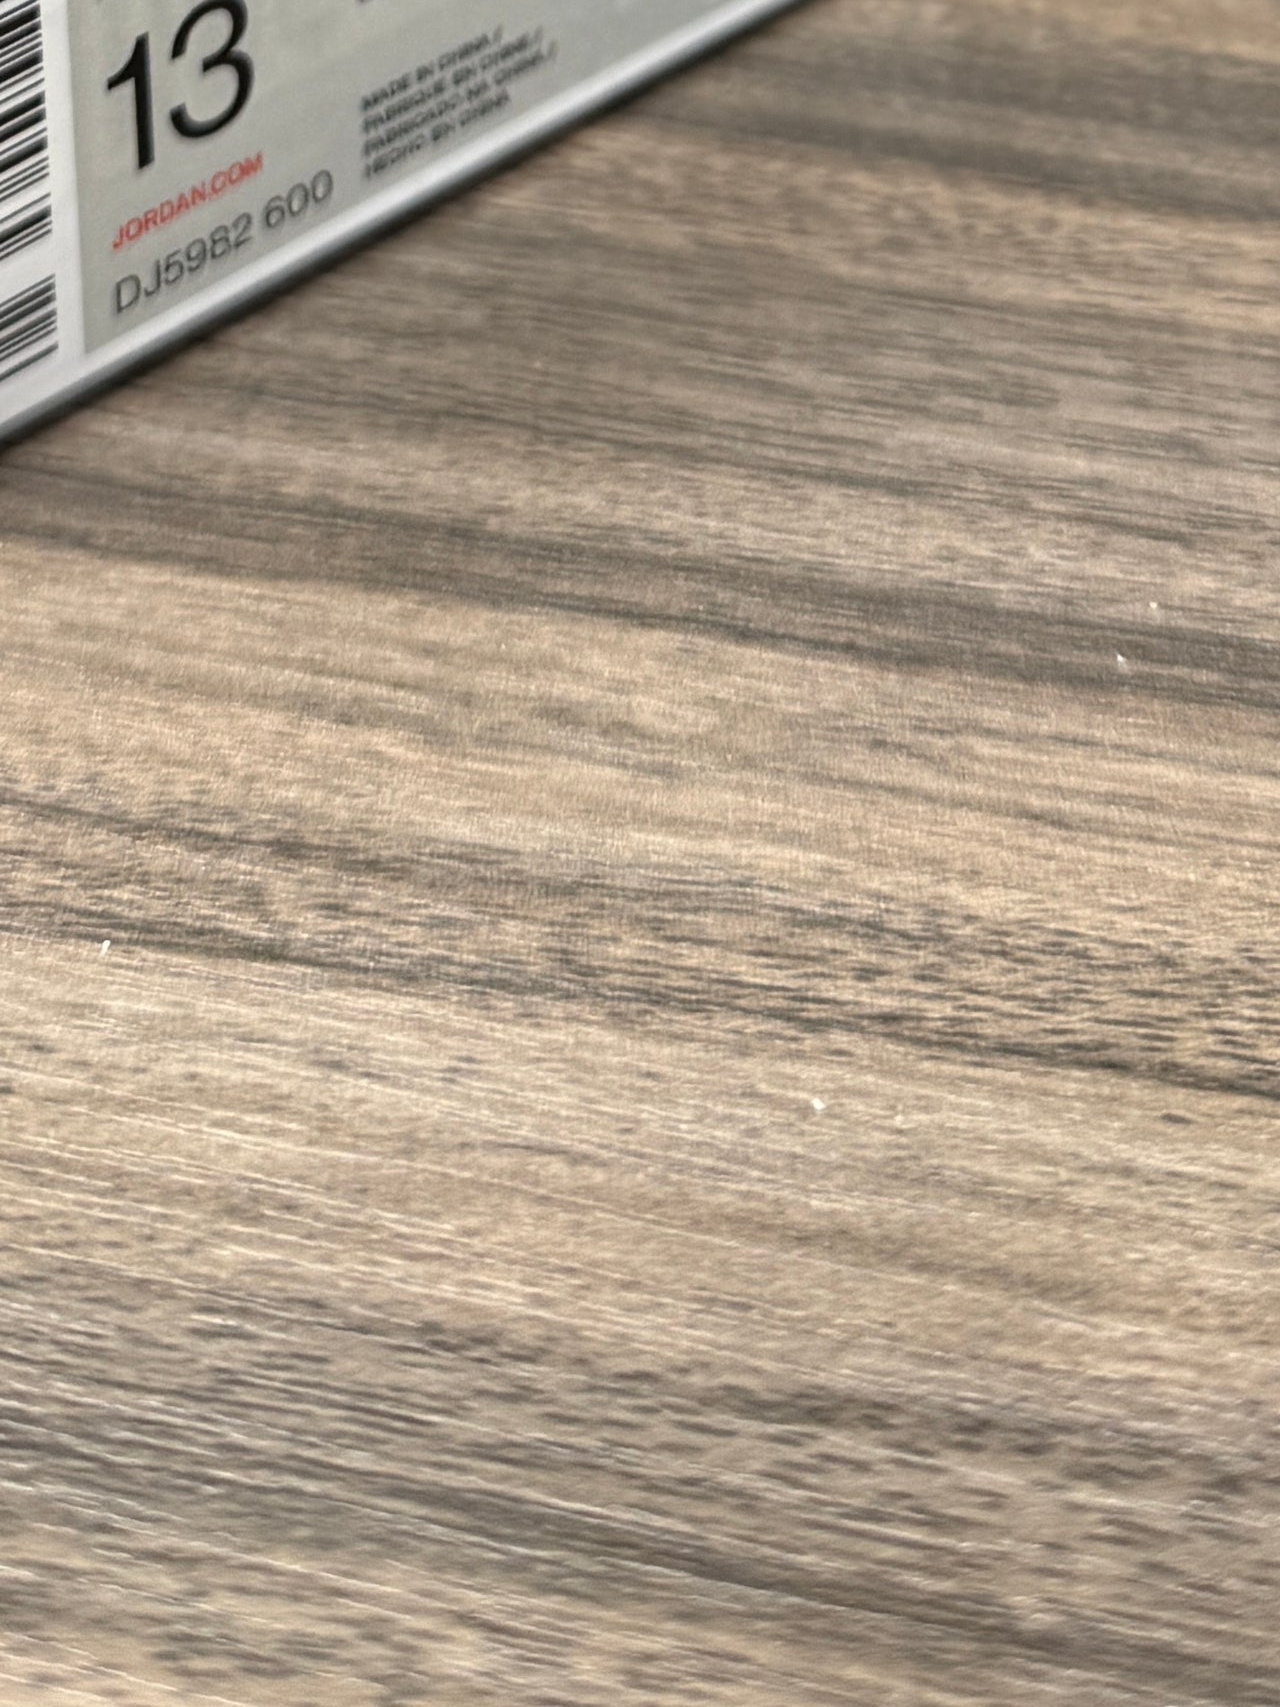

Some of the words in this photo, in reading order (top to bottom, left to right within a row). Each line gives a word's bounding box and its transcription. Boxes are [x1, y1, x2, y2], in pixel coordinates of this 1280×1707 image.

[113, 151, 263, 252] JORDAN.COM
[113, 212, 253, 314] DJ5982
[264, 169, 334, 228] 600
